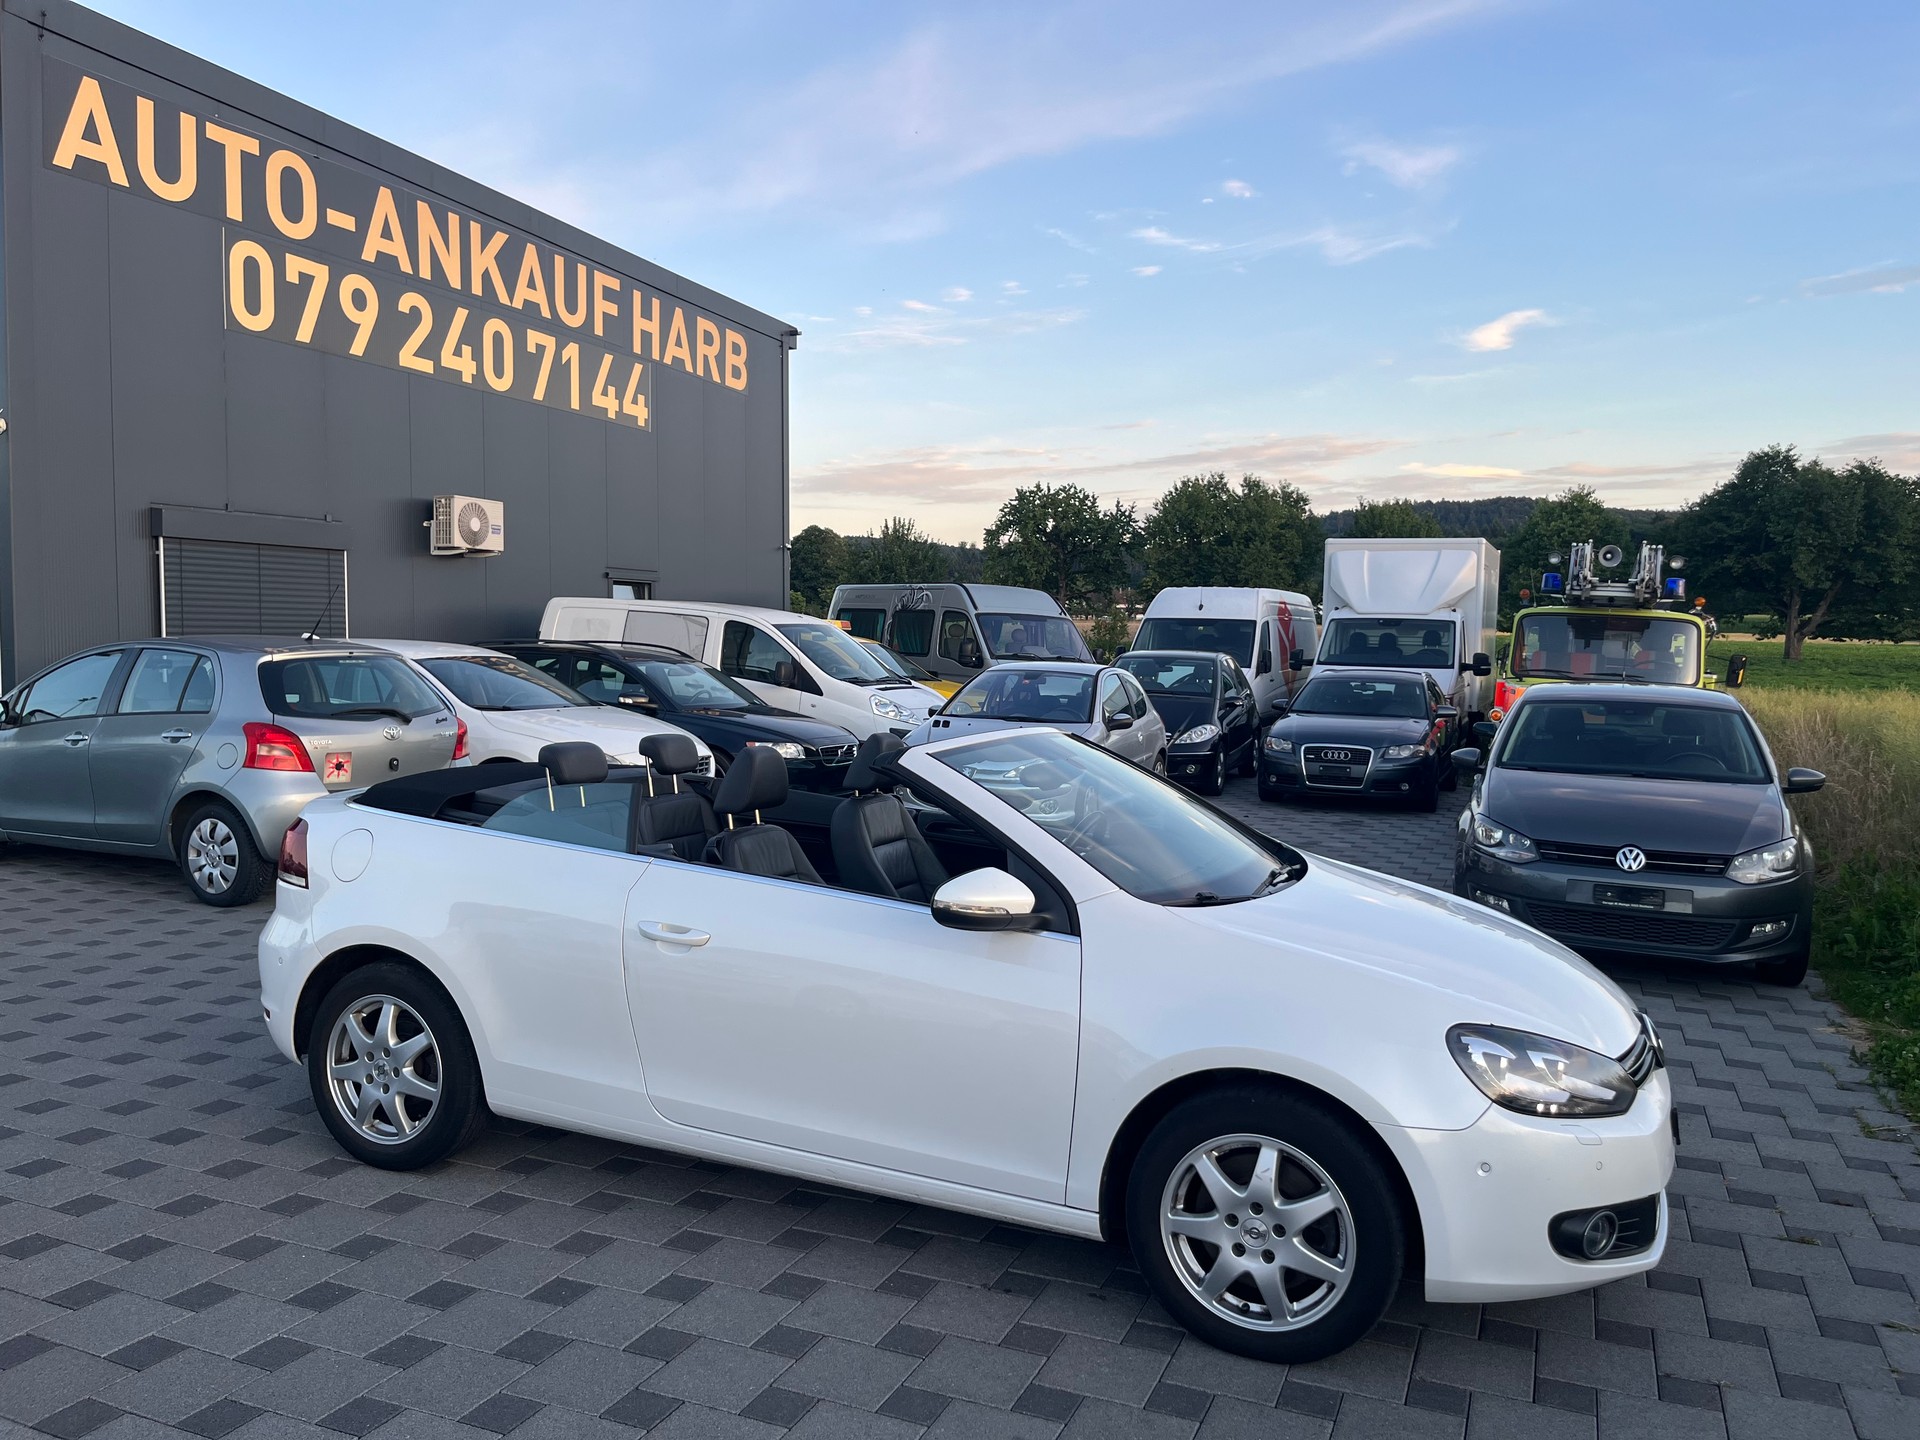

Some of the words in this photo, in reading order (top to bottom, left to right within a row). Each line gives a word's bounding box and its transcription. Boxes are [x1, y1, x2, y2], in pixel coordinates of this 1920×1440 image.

[52, 76, 621, 337] AUTO-ANKAUF
[632, 290, 748, 391] HARB
[229, 239, 380, 357] 079
[397, 291, 514, 392] 240
[526, 328, 580, 411] 71
[591, 353, 649, 427] 44
